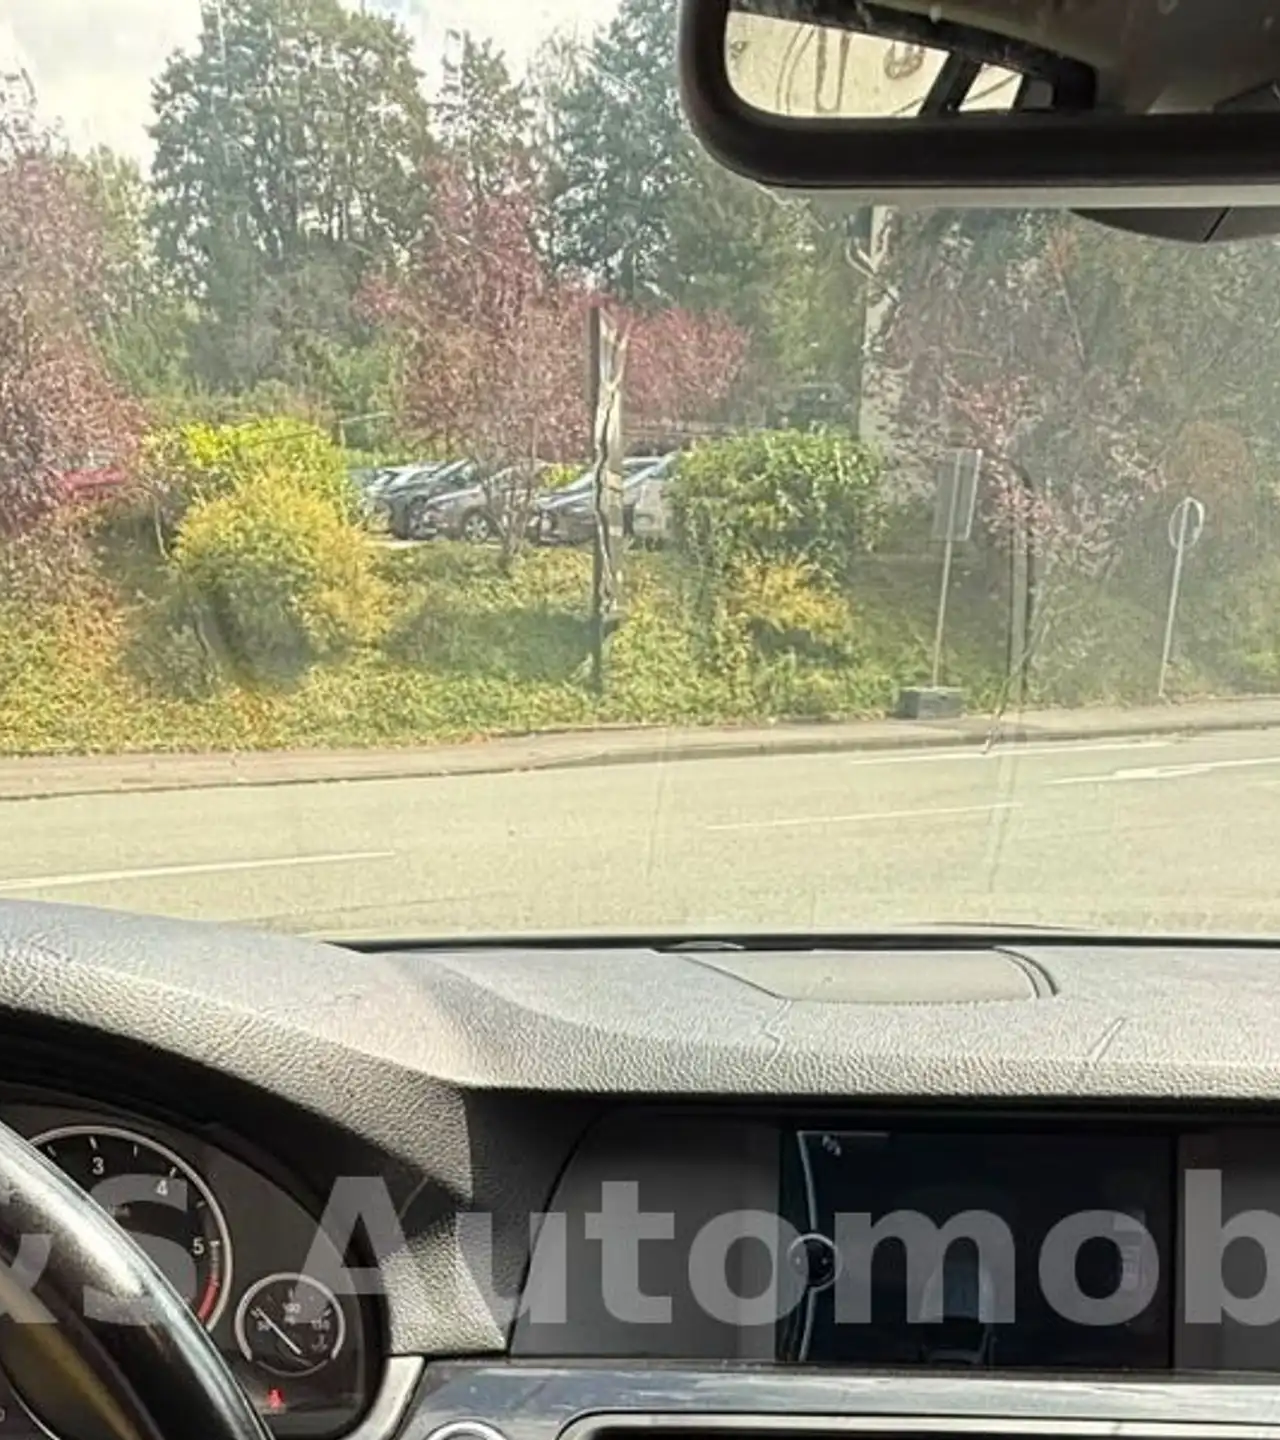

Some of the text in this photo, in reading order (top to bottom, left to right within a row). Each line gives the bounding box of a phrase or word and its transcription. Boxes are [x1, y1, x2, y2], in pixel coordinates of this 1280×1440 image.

[91, 1157, 105, 1175] 3
[156, 1179, 168, 1197] 4
[192, 1238, 205, 1255] 5
